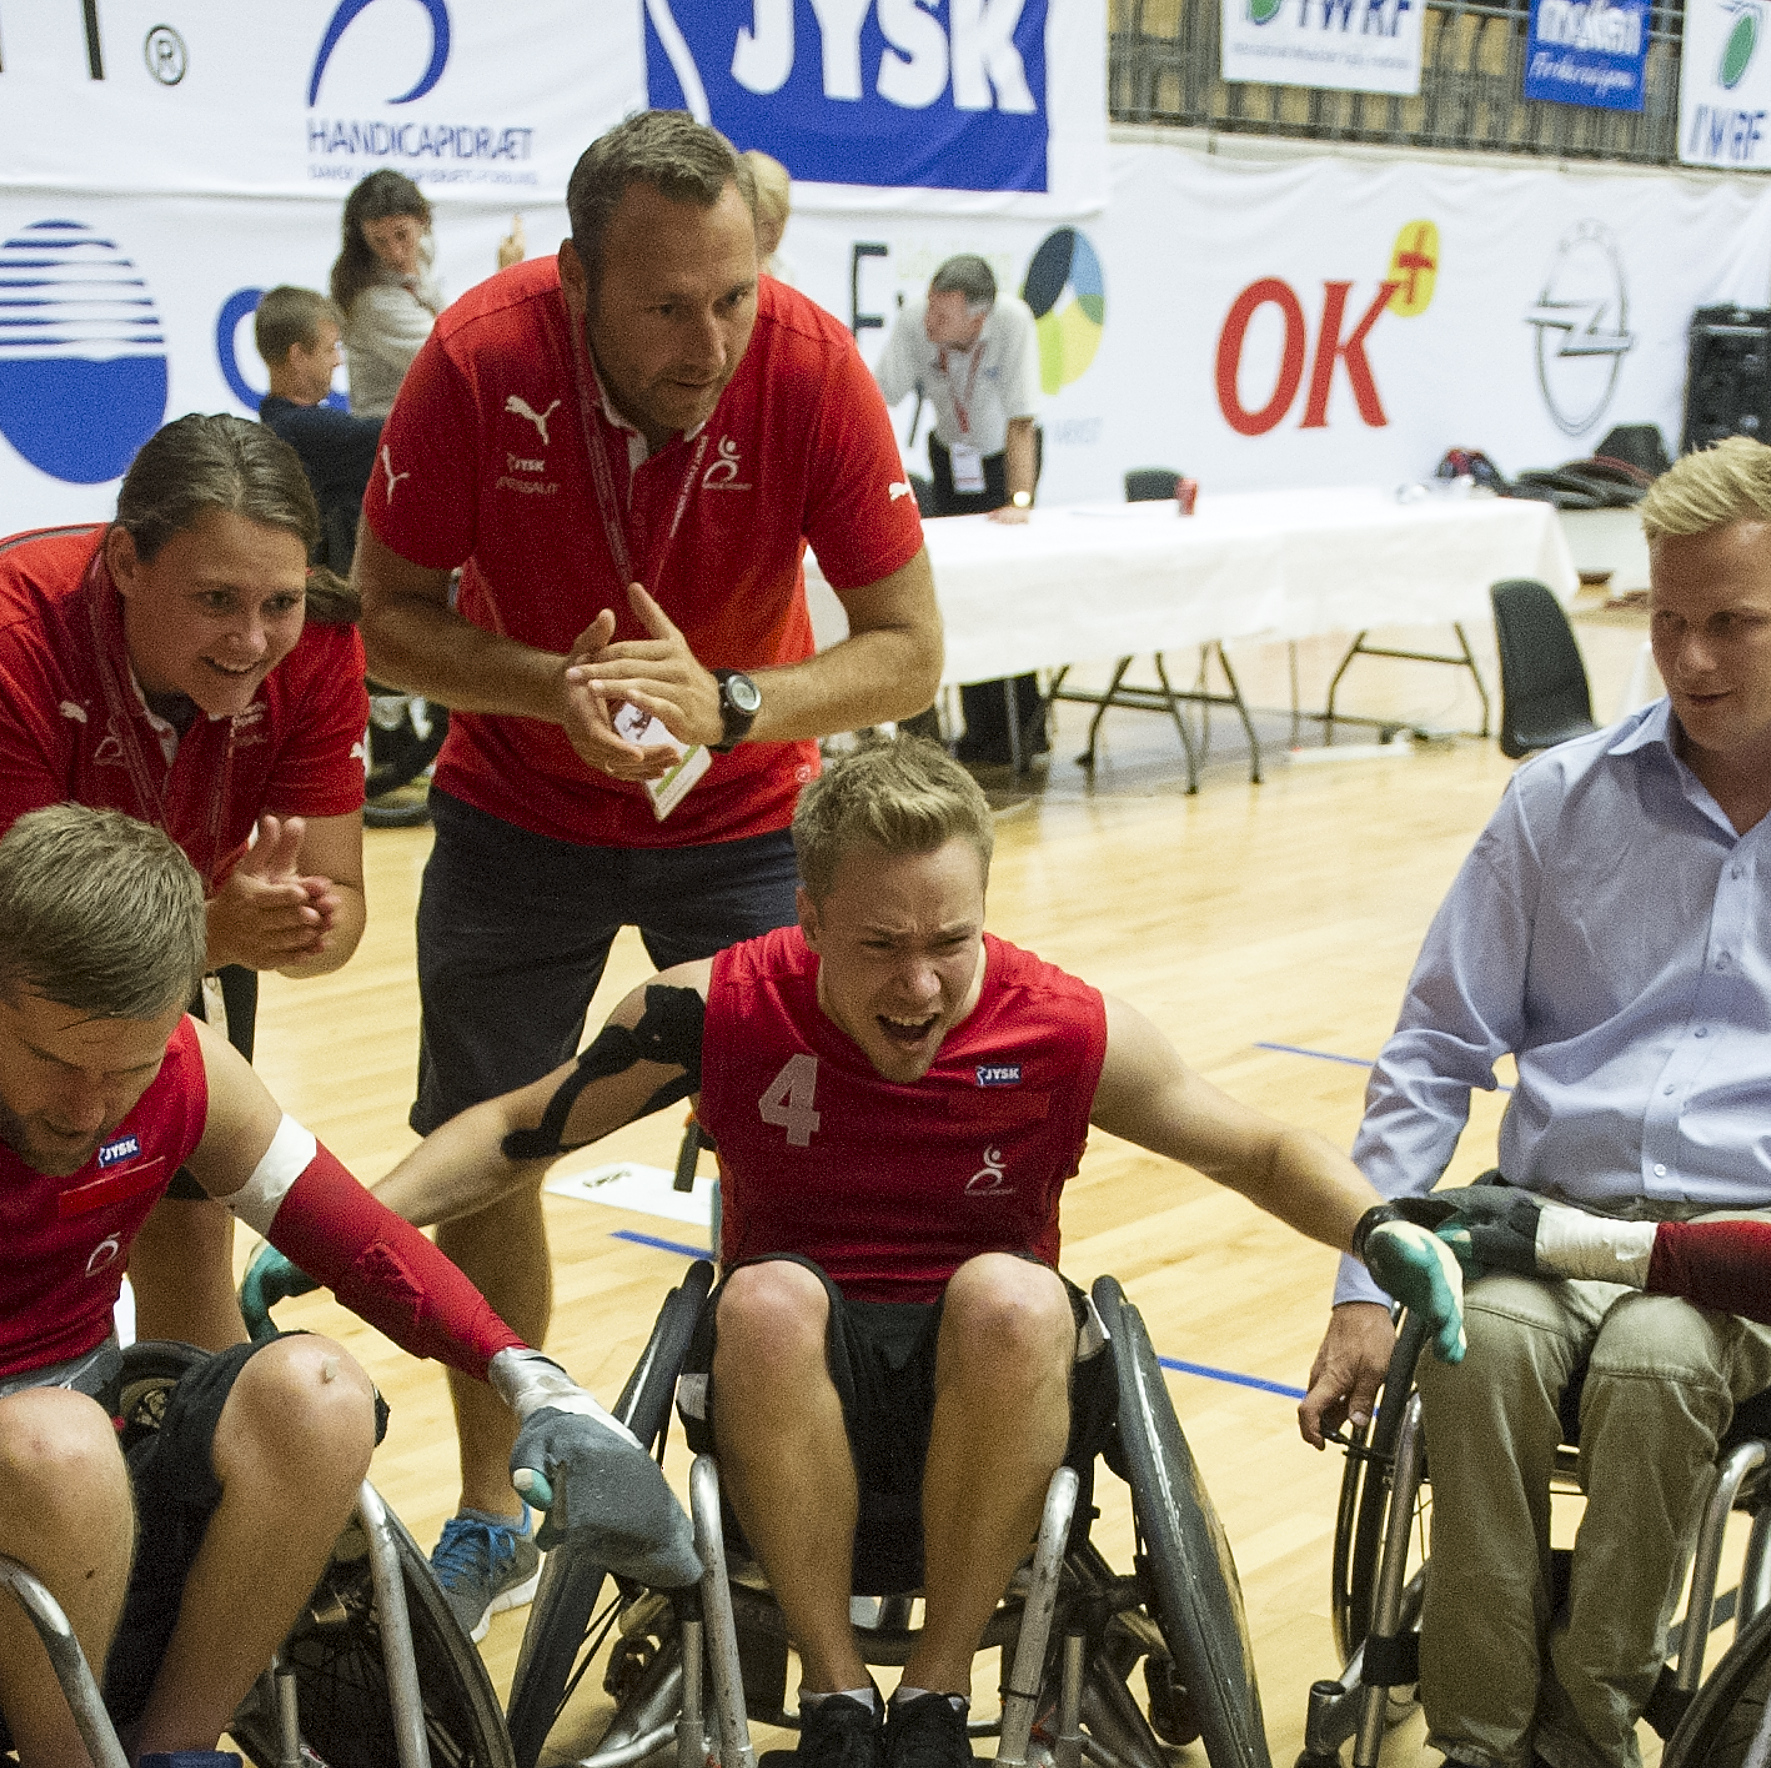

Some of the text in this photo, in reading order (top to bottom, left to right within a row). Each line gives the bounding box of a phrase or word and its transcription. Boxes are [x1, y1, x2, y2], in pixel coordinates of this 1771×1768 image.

[730, 0, 1040, 115] JYSK
[757, 1052, 822, 1148] 4
[985, 1067, 1020, 1080] JYSK
[104, 1138, 139, 1162] JYSK
